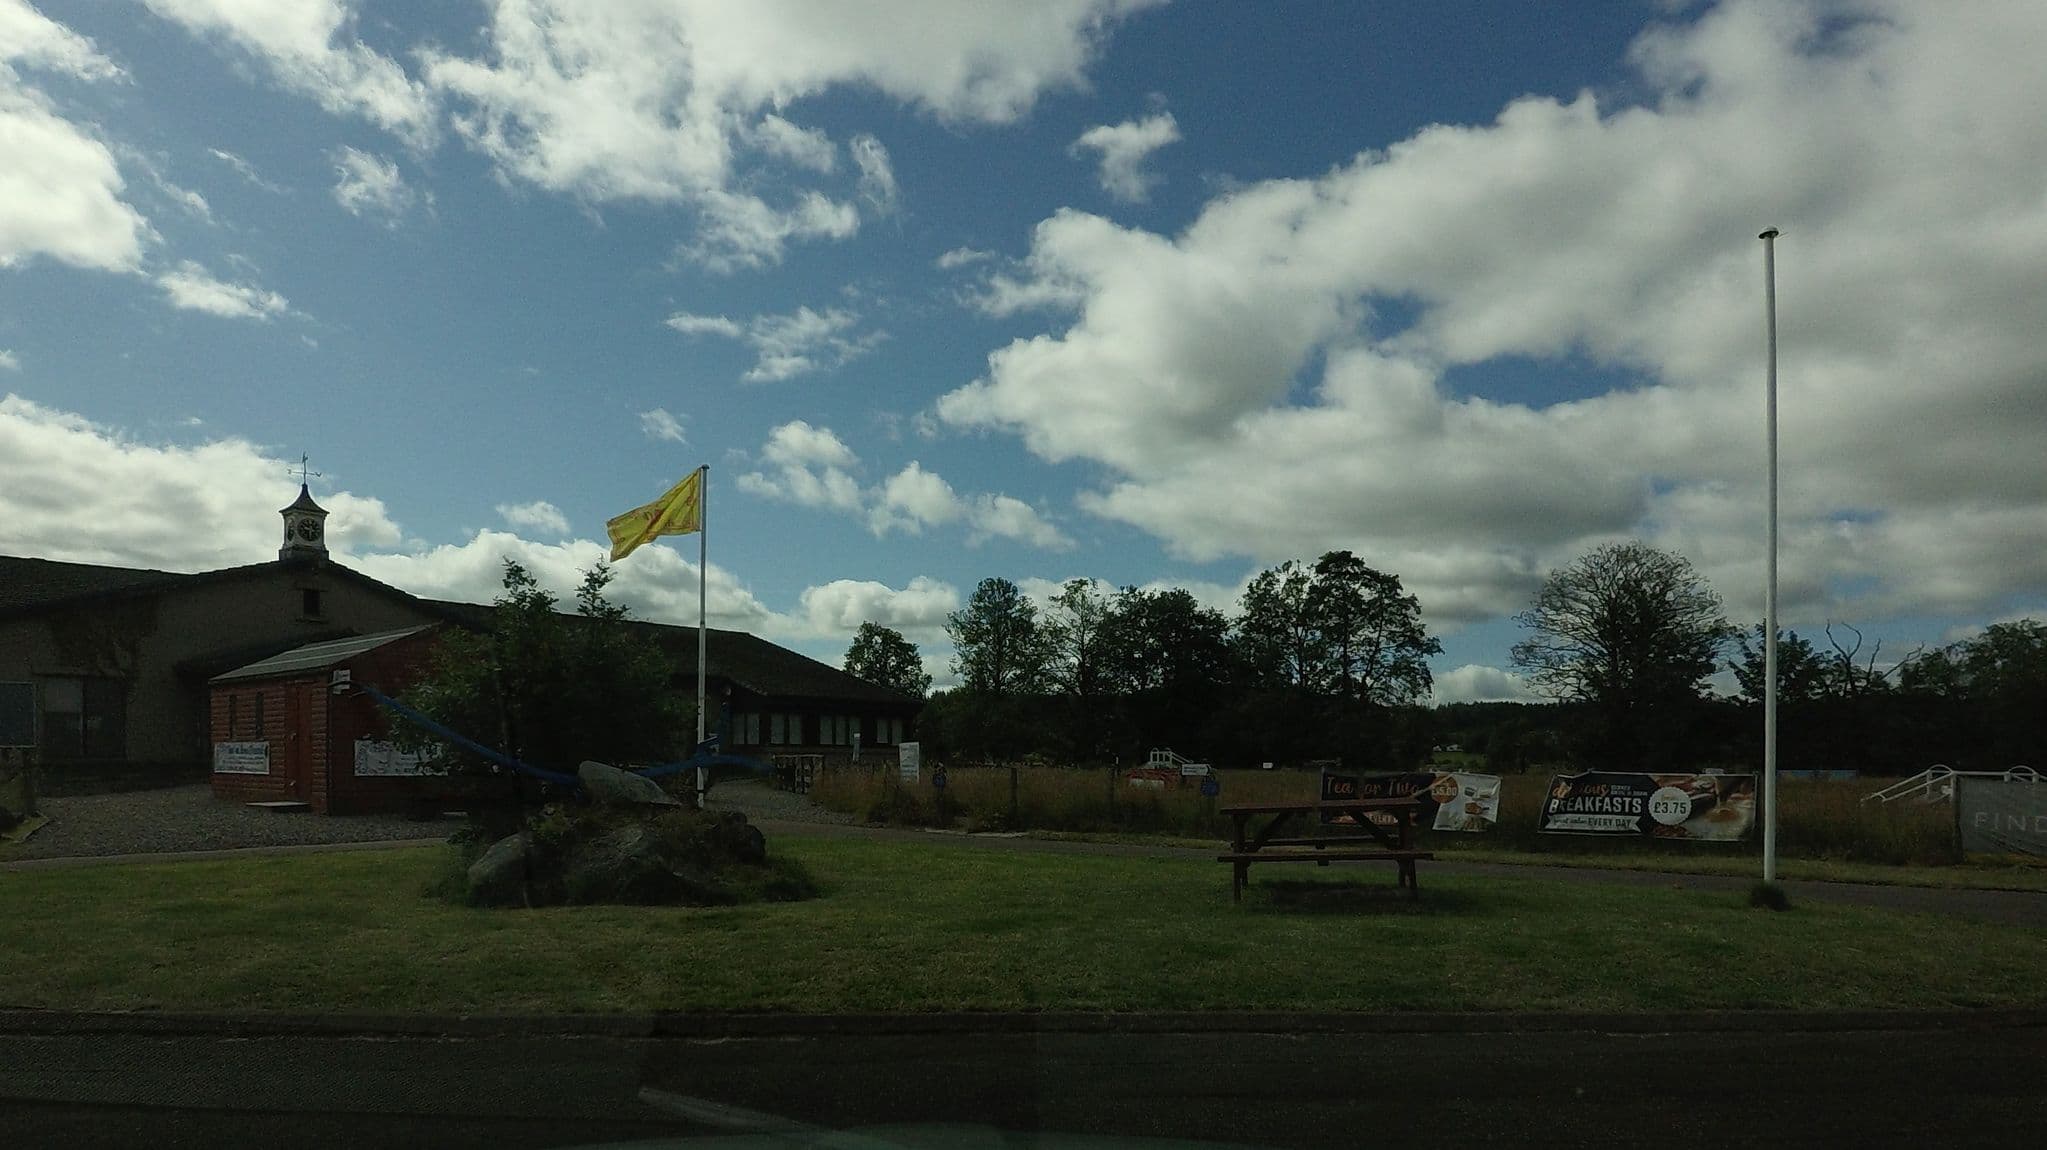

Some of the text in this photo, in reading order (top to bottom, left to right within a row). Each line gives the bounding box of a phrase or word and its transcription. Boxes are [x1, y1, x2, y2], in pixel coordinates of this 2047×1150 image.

[1548, 797, 1642, 814] BREAKFASTS
[1654, 802, 1687, 815] £3.75
[1615, 818, 1632, 829] DAY
